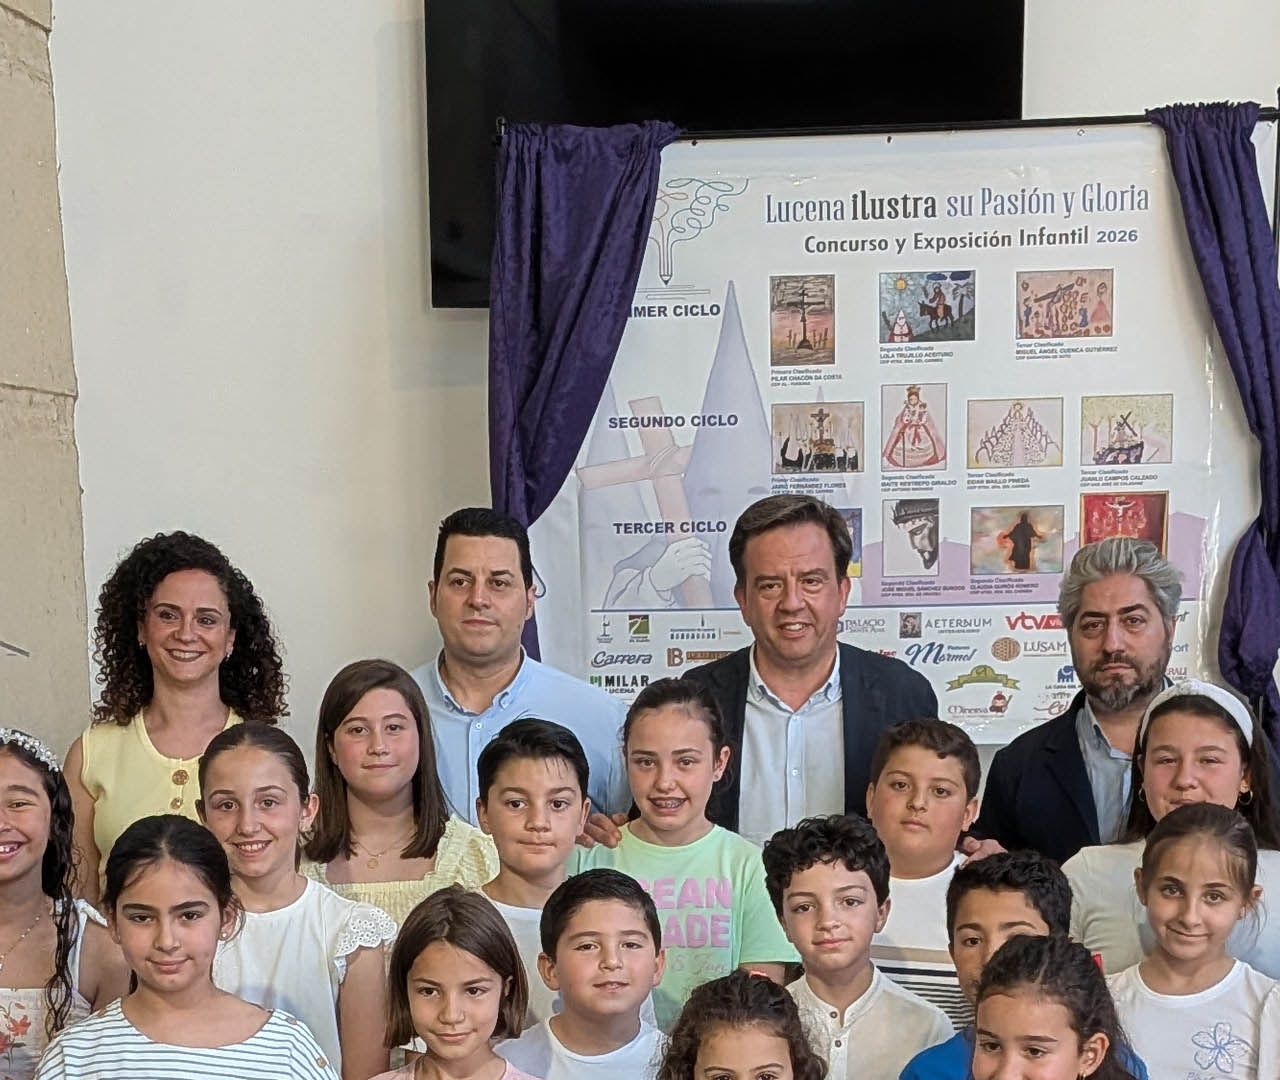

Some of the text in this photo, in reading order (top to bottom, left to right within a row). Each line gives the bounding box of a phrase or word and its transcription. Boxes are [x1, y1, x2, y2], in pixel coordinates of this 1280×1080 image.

[766, 182, 1149, 223] Lucena ilustra su Pasión y Gloria
[804, 226, 1138, 255] Concurso y Exposición Infantil 2026
[629, 304, 720, 318] IMER CICLO
[608, 414, 739, 429] SEGUNDO CICLO
[613, 521, 727, 534] TERCER CICLO
[925, 618, 992, 628] AETERNUM
[1023, 640, 1067, 652] LUSAM
[591, 651, 653, 668] Carrera
[605, 675, 650, 687] MILAR
[639, 878, 732, 909] EAN
[663, 914, 730, 948] ADE
